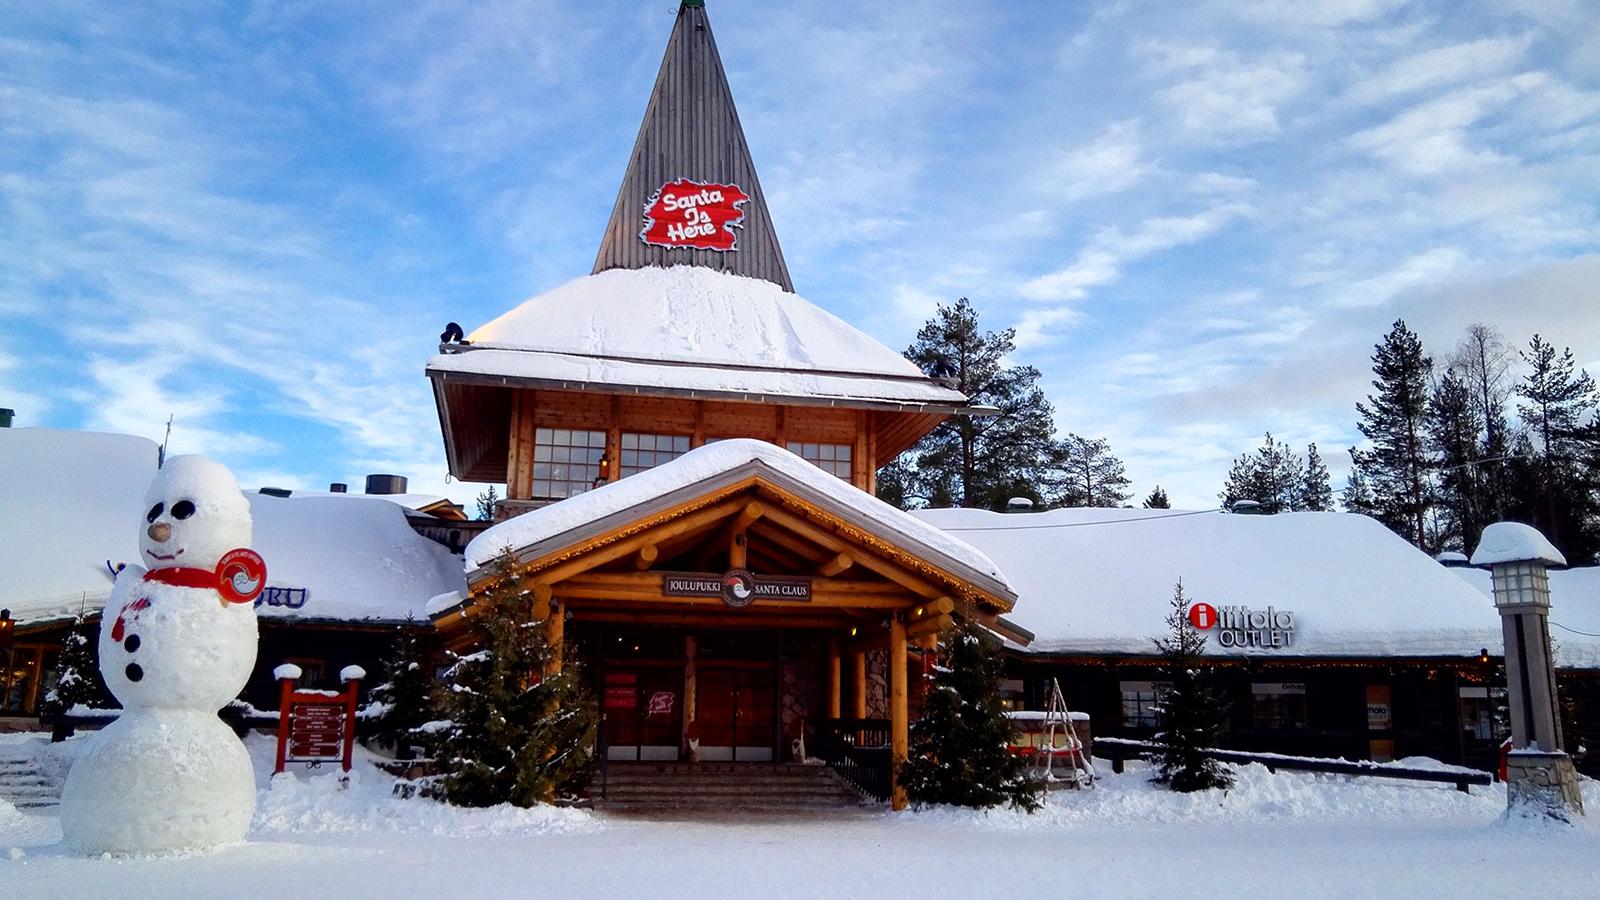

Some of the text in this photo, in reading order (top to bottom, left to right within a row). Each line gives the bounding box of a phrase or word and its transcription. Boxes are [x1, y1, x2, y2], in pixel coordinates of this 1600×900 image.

[663, 189, 725, 212] Santa
[667, 222, 717, 242] Here
[670, 580, 807, 596] JOULUPUKKI SANTA CLAUS
[1218, 605, 1295, 629] iittala
[1219, 630, 1295, 647] OUTLET
